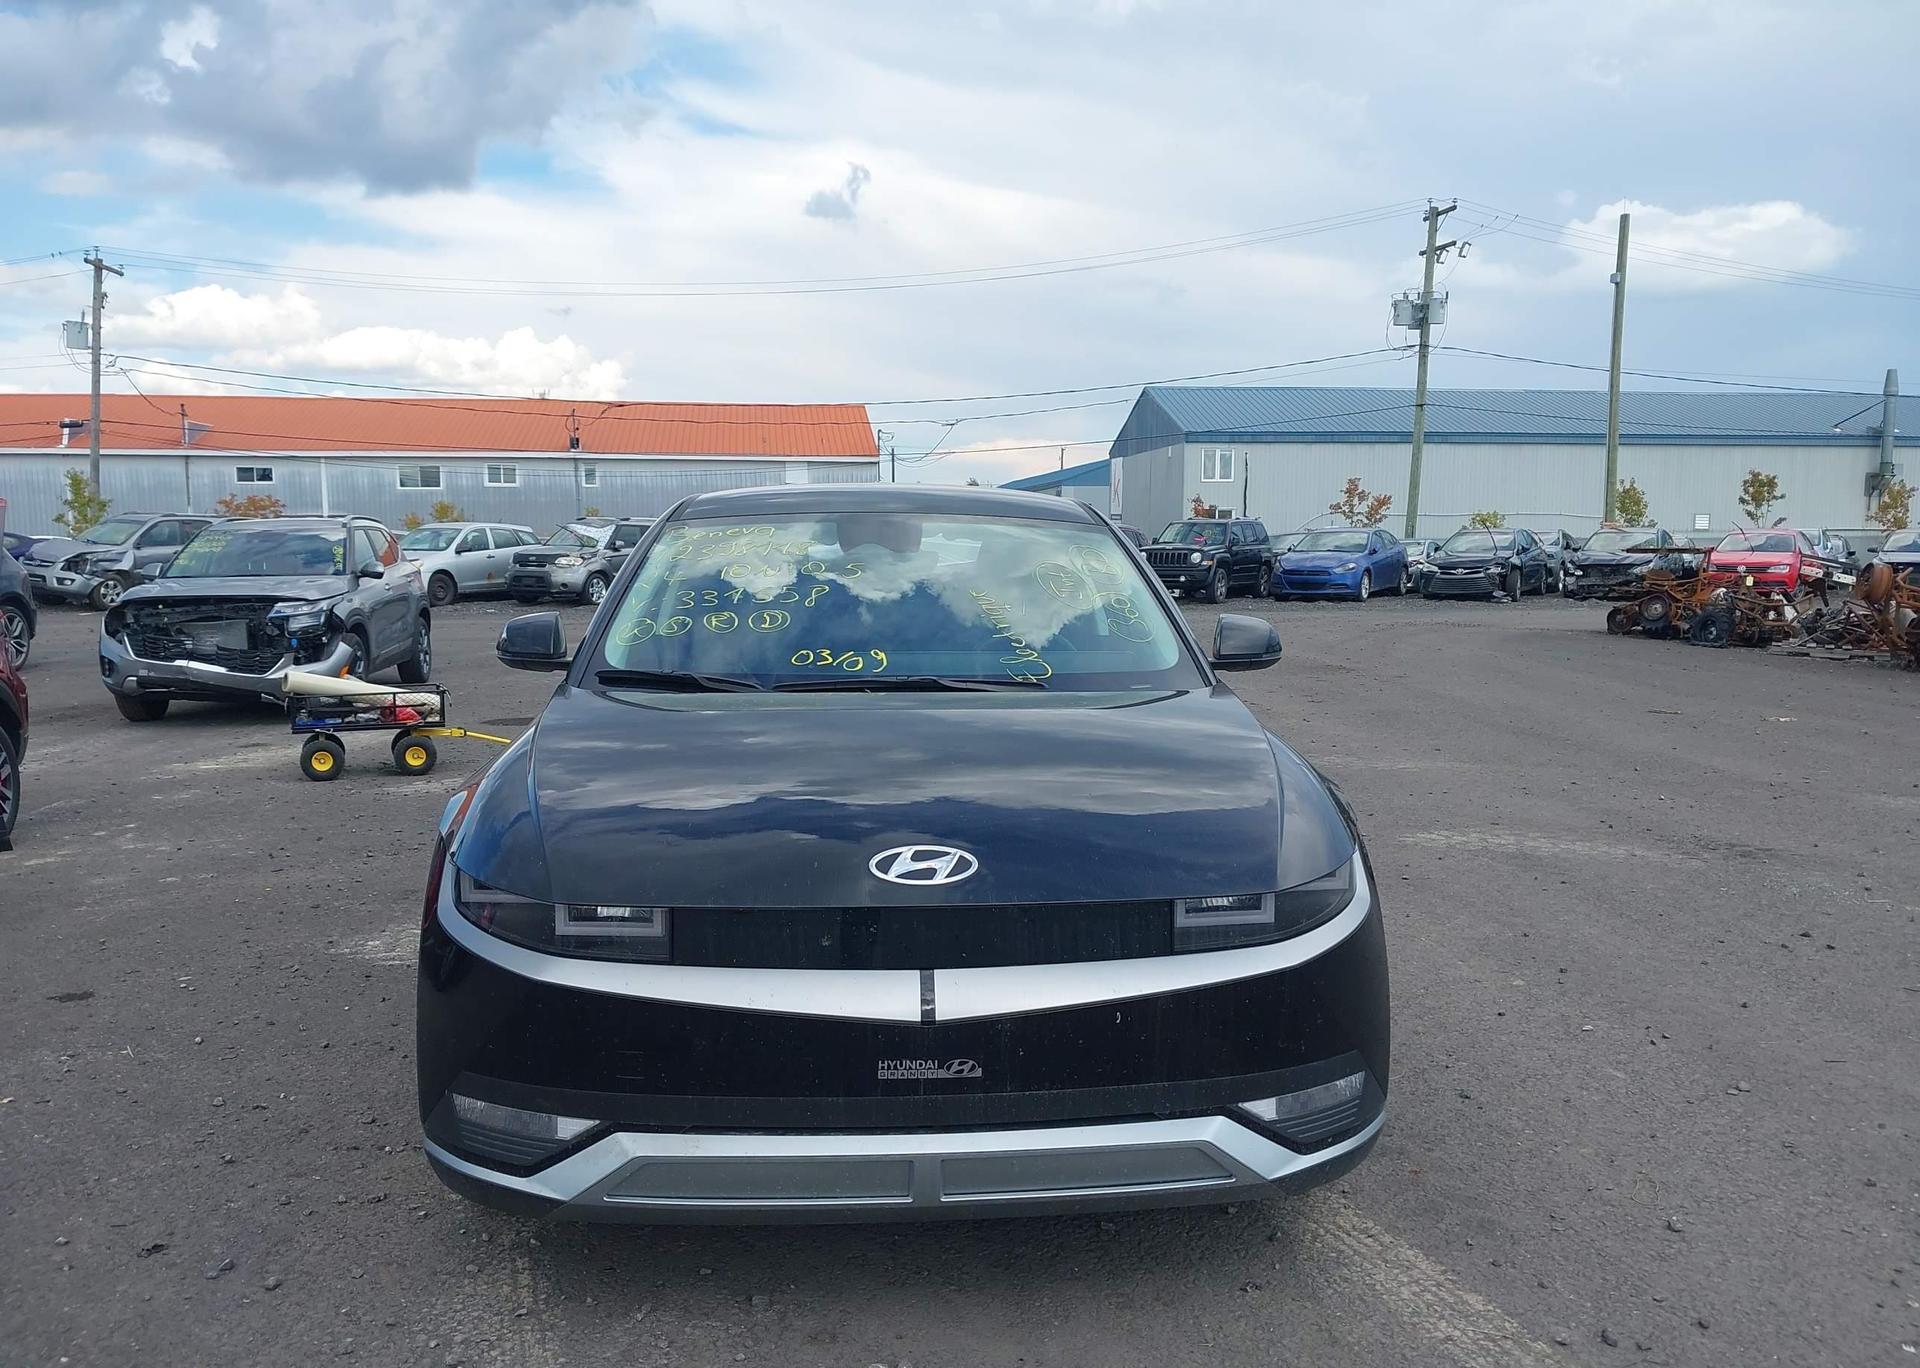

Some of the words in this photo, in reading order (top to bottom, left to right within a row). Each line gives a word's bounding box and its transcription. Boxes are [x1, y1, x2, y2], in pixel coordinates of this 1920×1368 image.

[790, 648, 888, 673] 03/09
[878, 1059, 938, 1070] HYUNDAI
[877, 1070, 938, 1080] GRANBY
